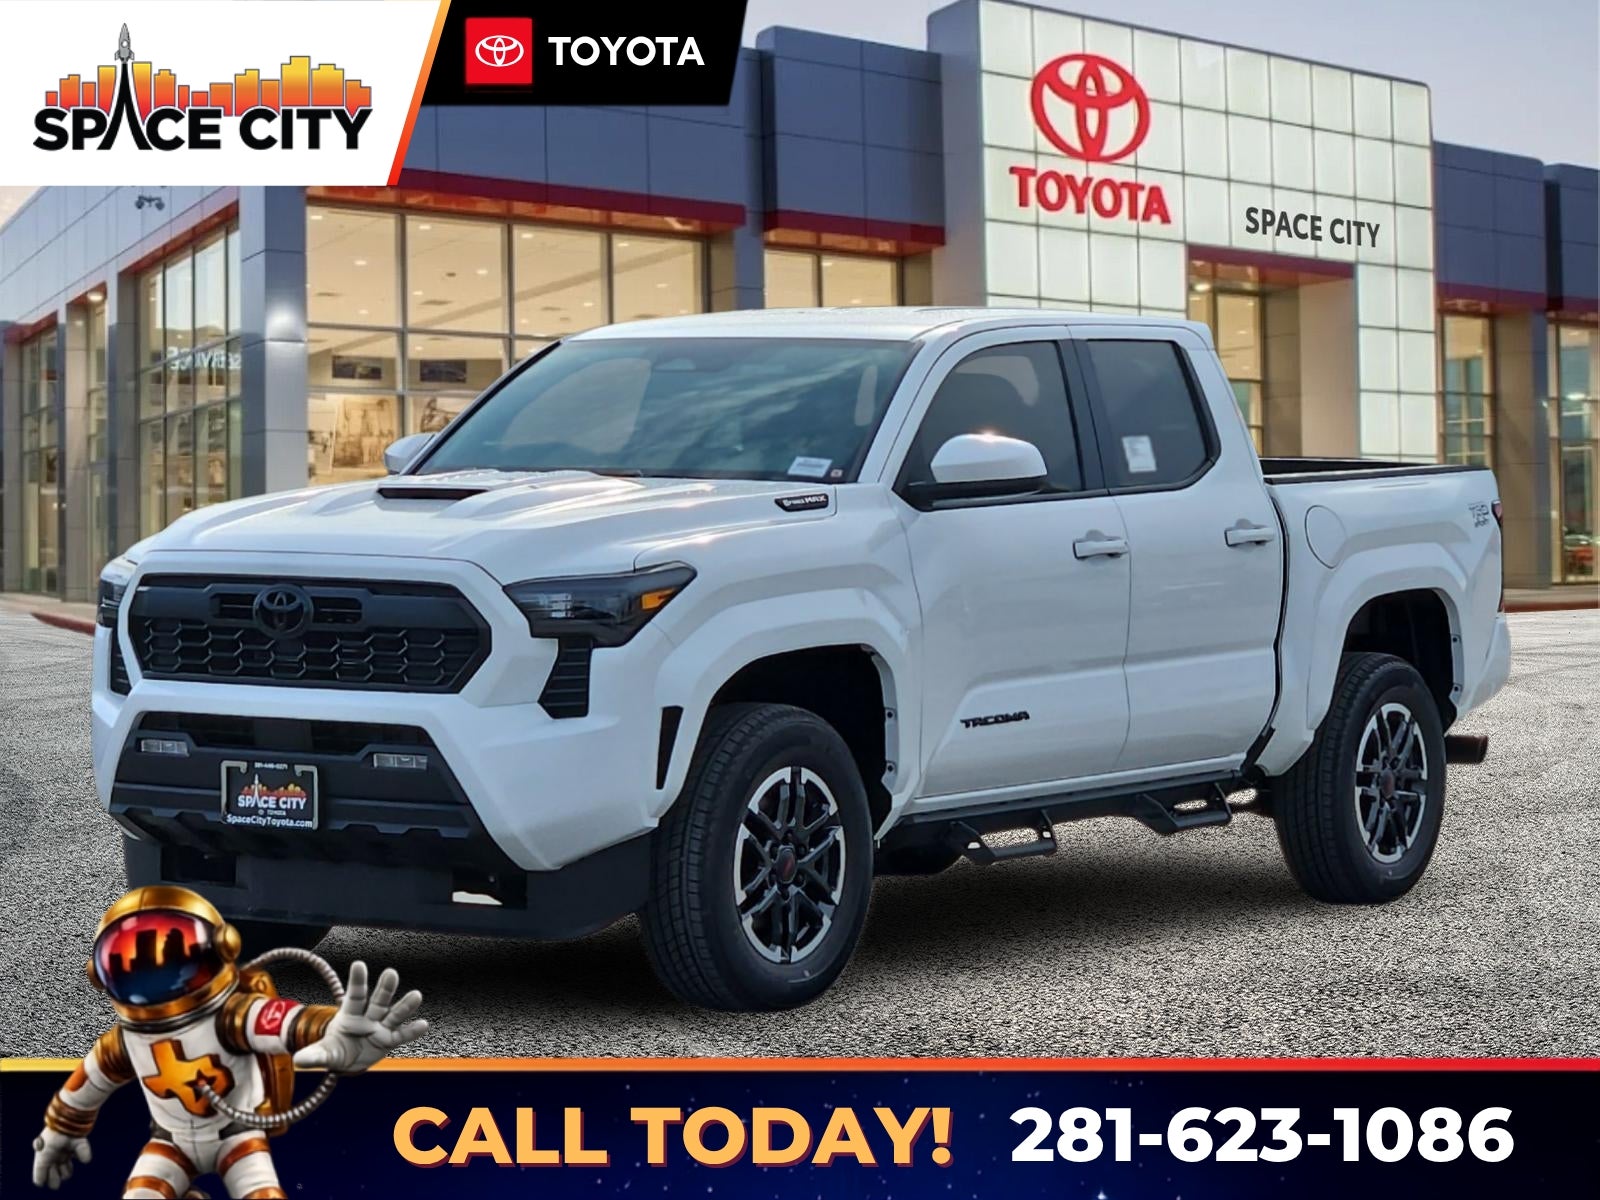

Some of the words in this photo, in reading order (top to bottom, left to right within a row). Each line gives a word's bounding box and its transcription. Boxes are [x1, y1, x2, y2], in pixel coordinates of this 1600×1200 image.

[1009, 166, 1171, 224] TOYOTA
[1245, 206, 1323, 242] SPACE
[1328, 217, 1381, 249] CITY
[960, 711, 1030, 728] TACOMA
[237, 794, 276, 808] SPACE
[279, 798, 307, 810] CITY
[226, 813, 313, 828] SpaceCityToyota.com
